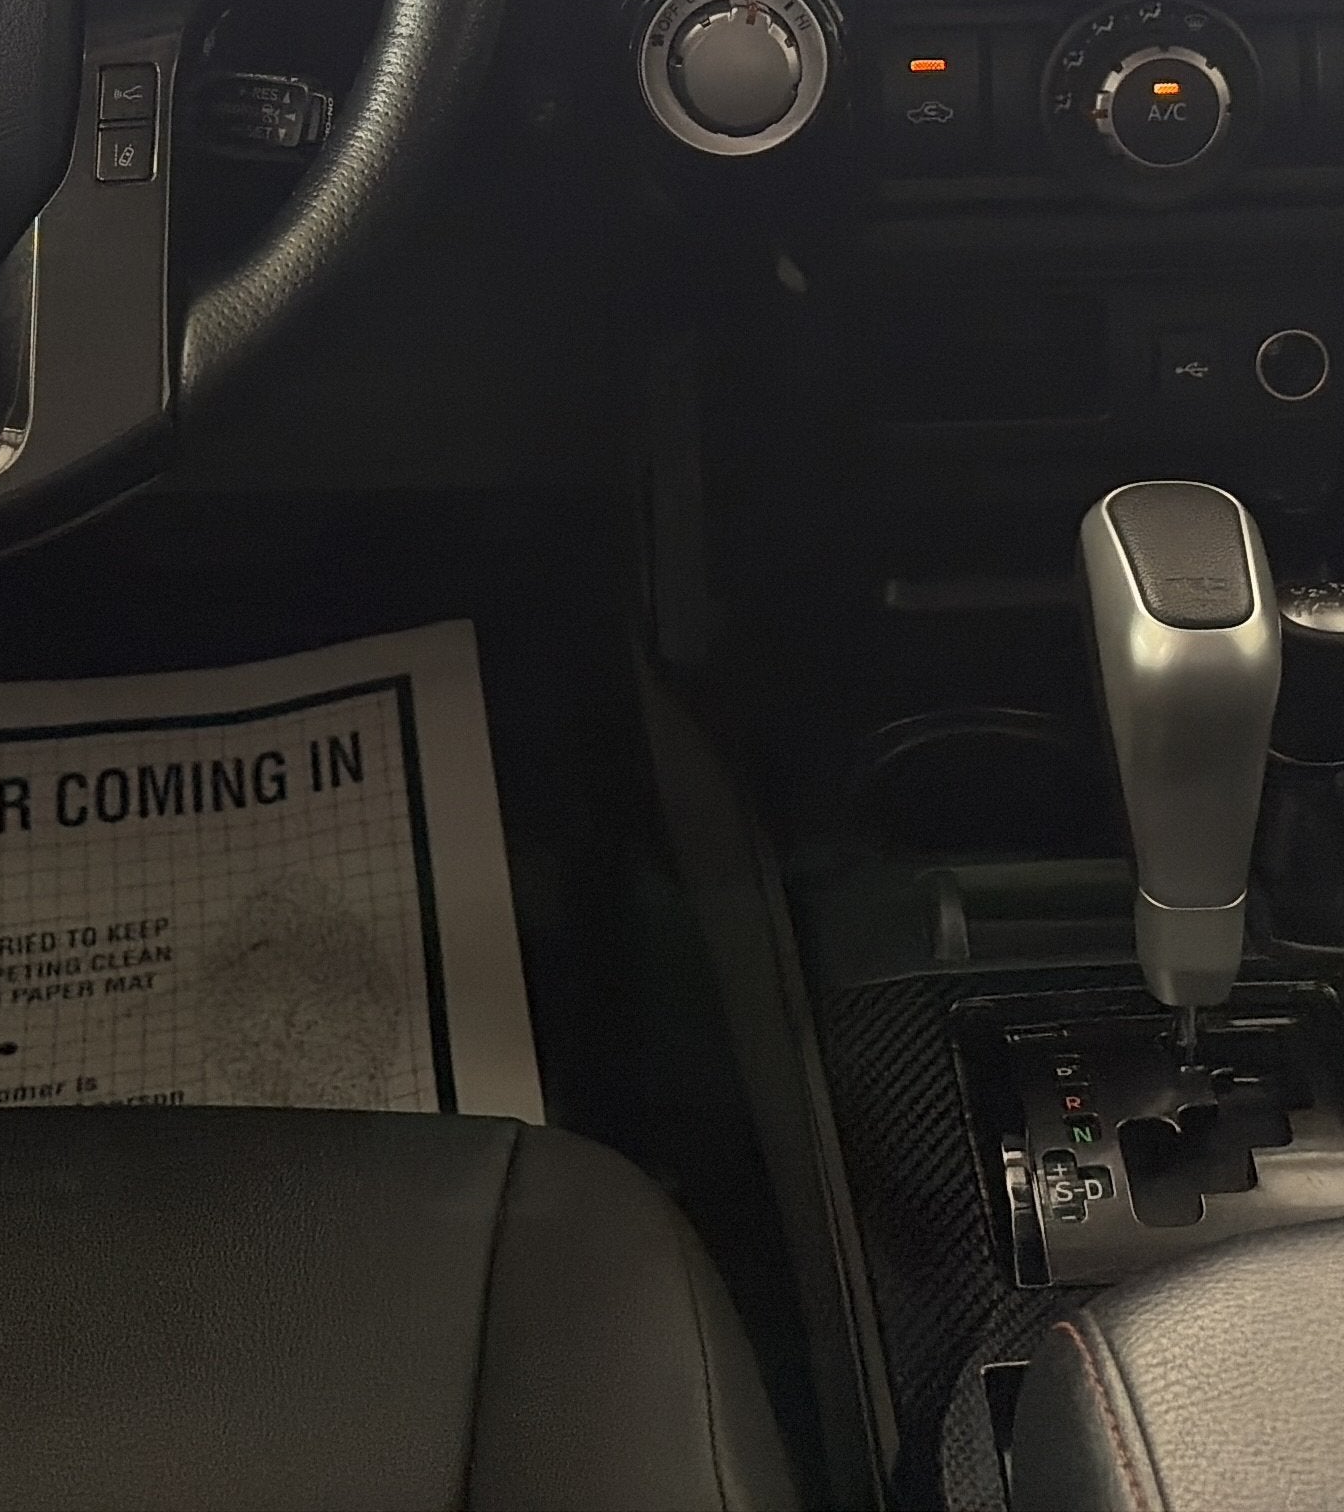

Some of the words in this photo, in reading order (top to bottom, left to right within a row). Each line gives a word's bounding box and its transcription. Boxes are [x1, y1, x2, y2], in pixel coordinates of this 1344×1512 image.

[658, 3, 680, 33] OFF
[794, 14, 812, 31] HI
[1148, 102, 1187, 122] A/C
[57, 750, 287, 827] COMING
[310, 730, 364, 792] IN
[67, 926, 97, 948] TO
[108, 916, 169, 942] KEEP
[91, 945, 173, 972] CLEAN
[10, 980, 95, 1006] PAPER
[105, 971, 156, 996] MAT
[1065, 1096, 1081, 1111] R
[1072, 1126, 1093, 1144] N
